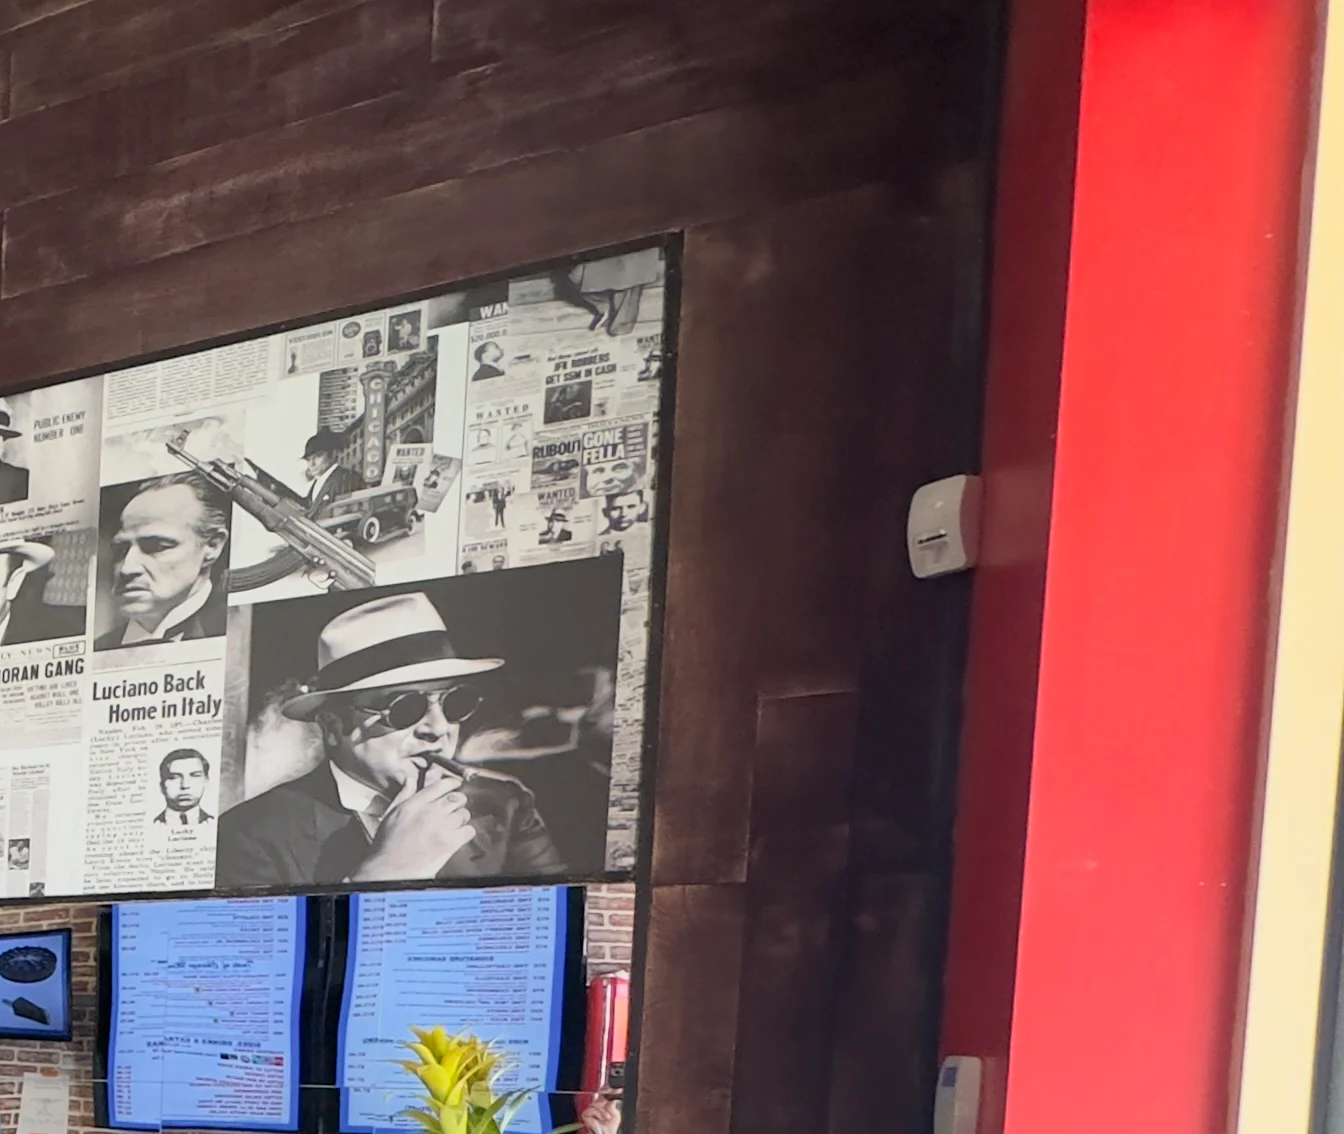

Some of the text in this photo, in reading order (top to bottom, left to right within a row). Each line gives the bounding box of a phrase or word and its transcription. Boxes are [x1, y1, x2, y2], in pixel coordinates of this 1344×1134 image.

[637, 334, 663, 345] WANT
[33, 410, 86, 430] PUBLIC ENEMY
[475, 404, 530, 421] WANTED
[33, 424, 84, 443] NUMBER ONE
[366, 377, 384, 478] CHICAGO
[583, 427, 624, 449] GONE
[583, 443, 626, 465] FELLA
[44, 658, 85, 678] GANG
[92, 669, 206, 701] Luciano Back
[108, 694, 222, 724] Home in Italy
